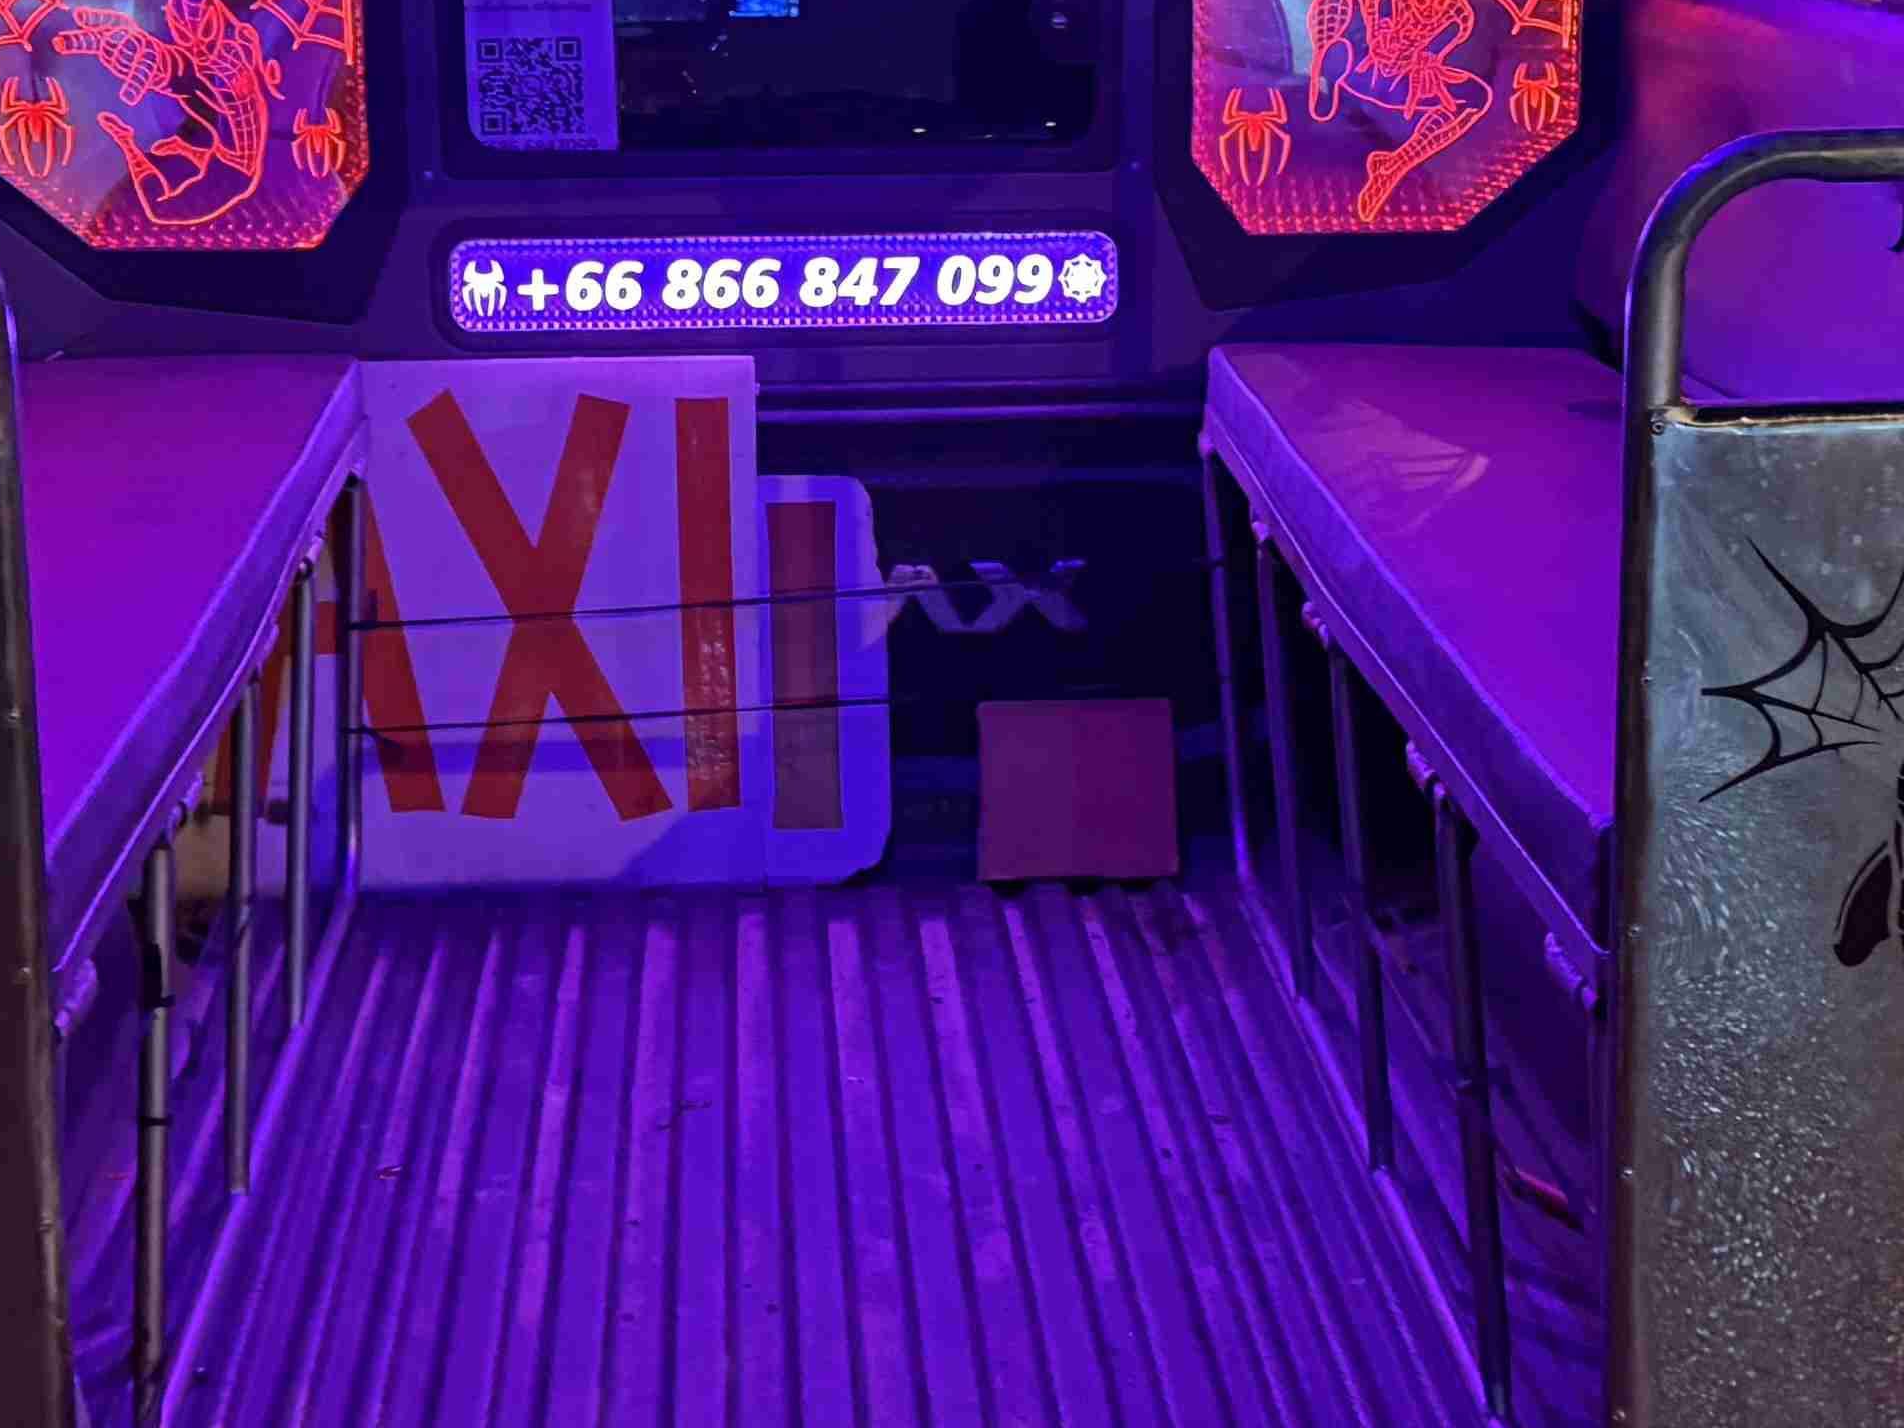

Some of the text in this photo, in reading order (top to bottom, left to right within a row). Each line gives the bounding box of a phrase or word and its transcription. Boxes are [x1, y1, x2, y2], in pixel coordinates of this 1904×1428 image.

[516, 254, 1055, 312] +66 866 847 099
